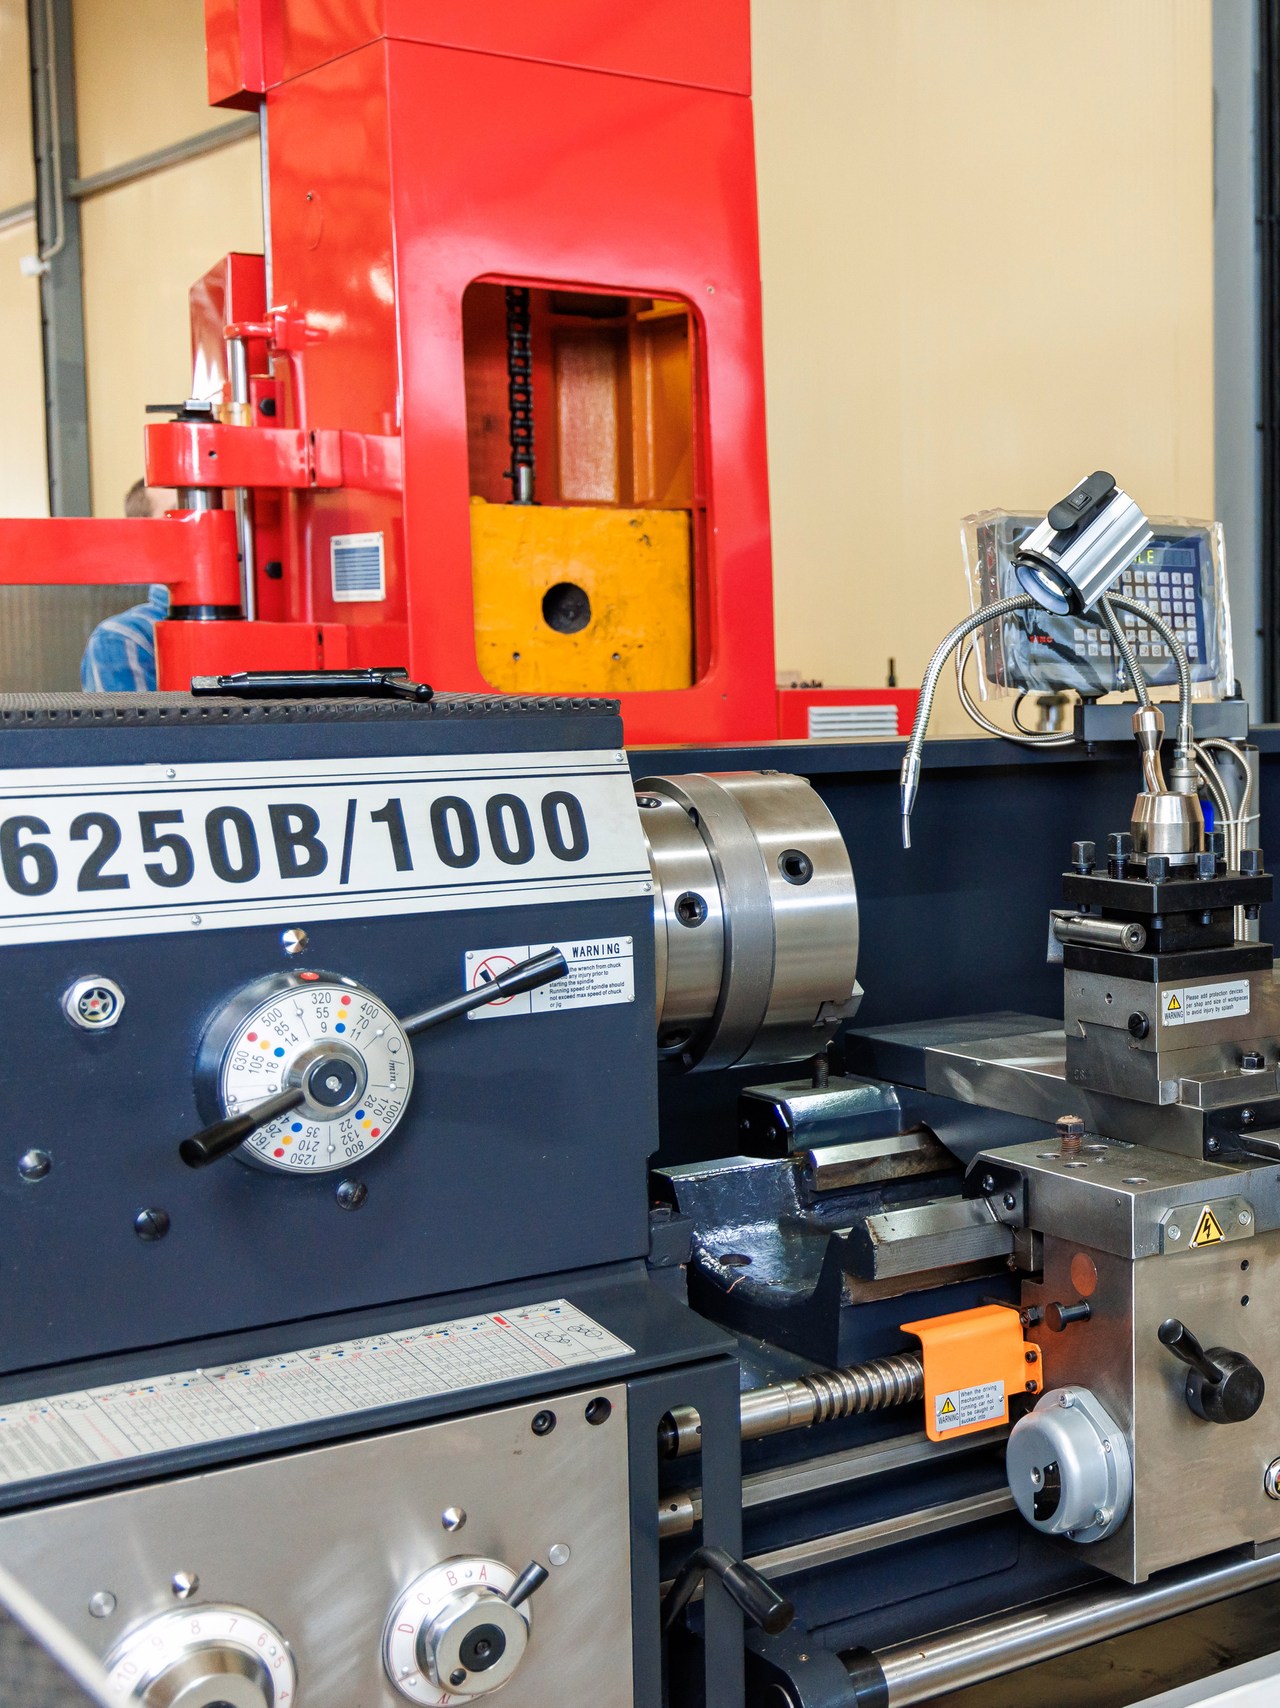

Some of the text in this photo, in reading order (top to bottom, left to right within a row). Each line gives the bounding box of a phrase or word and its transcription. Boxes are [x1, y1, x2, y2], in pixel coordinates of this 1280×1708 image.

[1, 791, 590, 897] 6250B/1000
[572, 943, 620, 958] WARNING
[311, 992, 332, 1004] 320
[1209, 990, 1228, 998] protection
[261, 1007, 283, 1027] 500
[316, 1007, 330, 1018] 55
[360, 1002, 379, 1019] 400
[1164, 1010, 1184, 1020] WARNING
[274, 1022, 290, 1036] 85
[320, 1022, 327, 1033] 9
[356, 1016, 370, 1030] 70
[284, 1032, 300, 1047] 14
[350, 1028, 362, 1041] 11
[232, 1050, 250, 1072] 630
[248, 1055, 265, 1075] 105
[265, 1061, 280, 1076] 18
[363, 1094, 378, 1109] 28
[372, 1098, 389, 1117] 170
[382, 1100, 401, 1124] 1000
[305, 1126, 320, 1138] 35
[338, 1119, 353, 1133] 22
[340, 1130, 360, 1145] 132
[298, 1140, 320, 1152] 210
[345, 1141, 365, 1157] 800
[290, 1153, 317, 1166] 1250
[961, 1395, 984, 1404] mechanism
[974, 1406, 989, 1415] caught
[938, 1413, 959, 1424] WARNING
[961, 1416, 976, 1424] sucked
[446, 1570, 458, 1586] B
[479, 1565, 487, 1580] A
[416, 1592, 431, 1606] C
[191, 1619, 200, 1634] 8
[228, 1618, 238, 1633] 7
[397, 1624, 414, 1634] D
[151, 1636, 164, 1650] 9
[257, 1633, 268, 1647] 6
[274, 1656, 286, 1668] 5
[279, 1691, 290, 1700] 4
